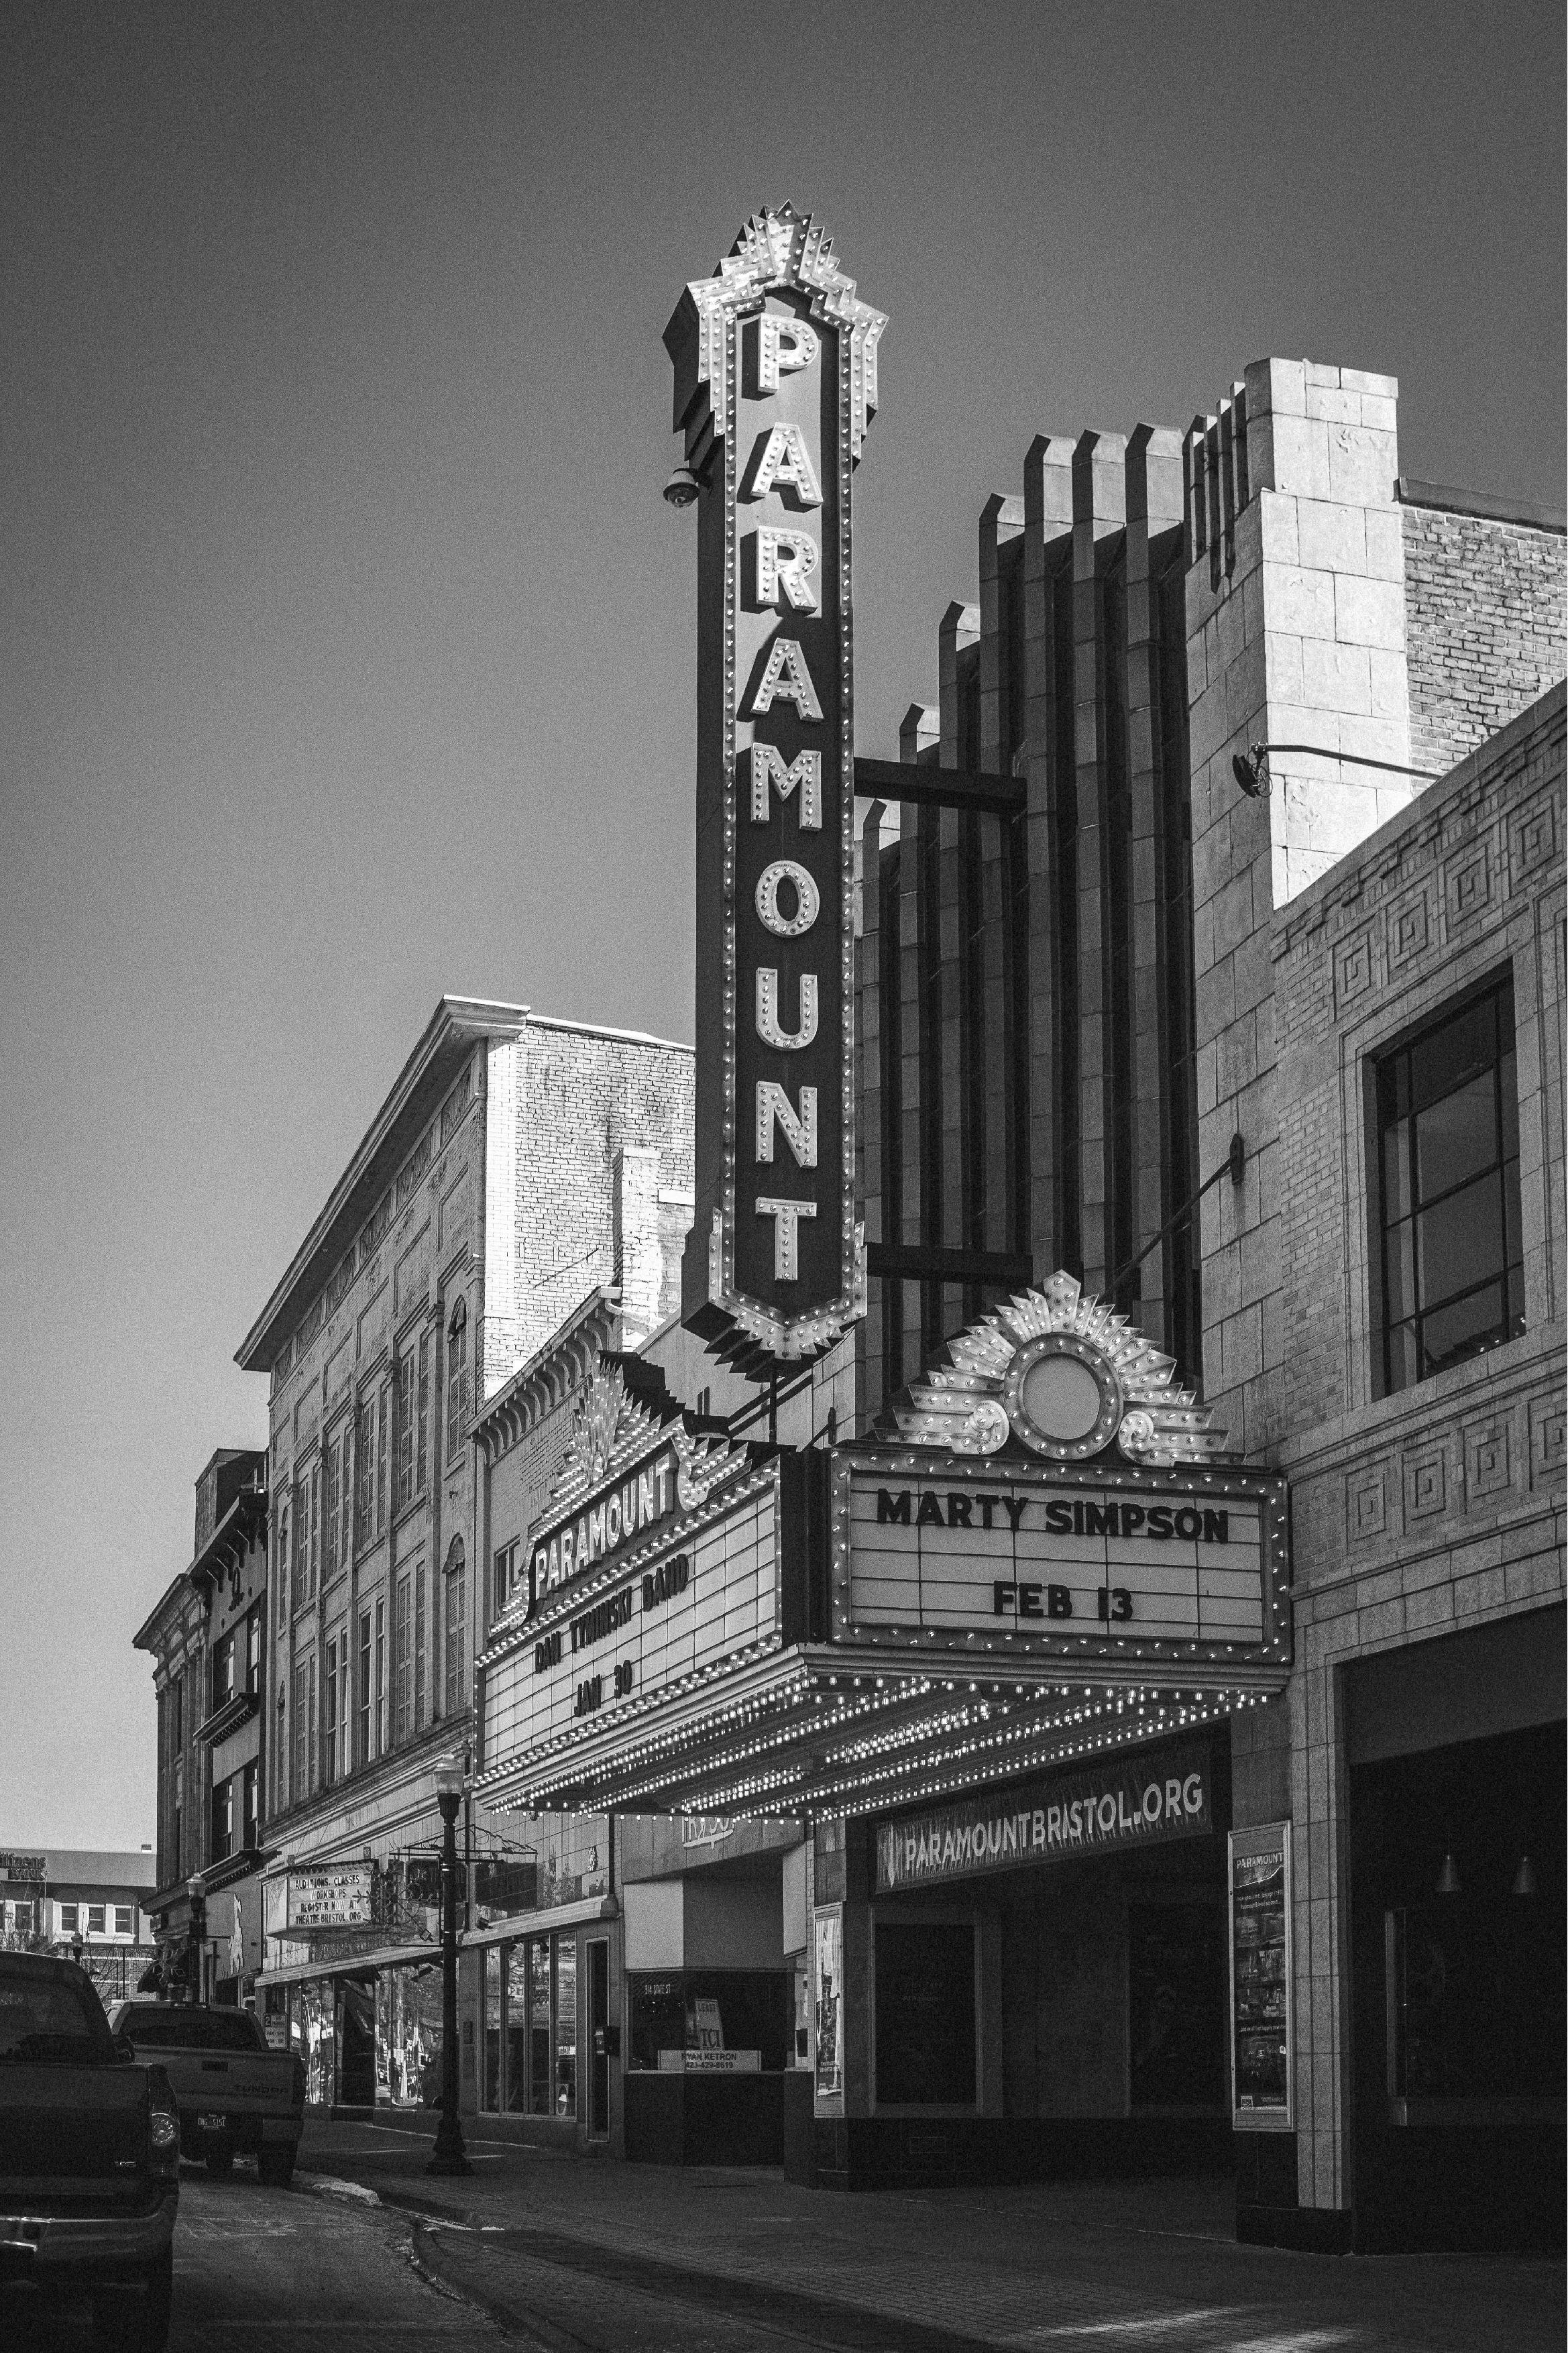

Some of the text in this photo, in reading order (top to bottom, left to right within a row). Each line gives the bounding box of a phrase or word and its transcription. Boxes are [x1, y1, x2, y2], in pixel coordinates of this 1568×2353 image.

[750, 312, 824, 1282] PARAMOUNT
[877, 1488, 1229, 1544] MARTY SIMPSON
[535, 1452, 673, 1600] PARAMOUNT
[993, 1580, 1133, 1623] FEB 13
[535, 1553, 689, 1674] DAN TYMINSKI BAND
[573, 1659, 633, 1718] JAN 30
[904, 1771, 1203, 1872] PARAMOUNTBRISTOL.ORG
[1237, 1852, 1284, 1869] PARAMOUNT
[7, 1868, 45, 1881] BANK
[333, 1874, 359, 1887] CLASSES
[311, 1888, 346, 1900] WORKSHOPS
[300, 1902, 329, 1912] REGISTER
[331, 1900, 345, 1910] NOW
[653, 1984, 665, 1995] STATE
[265, 2016, 270, 2026] 2
[699, 2028, 721, 2048] TCI
[704, 2053, 737, 2061] KETRON
[233, 2084, 289, 2094] TUNDRA
